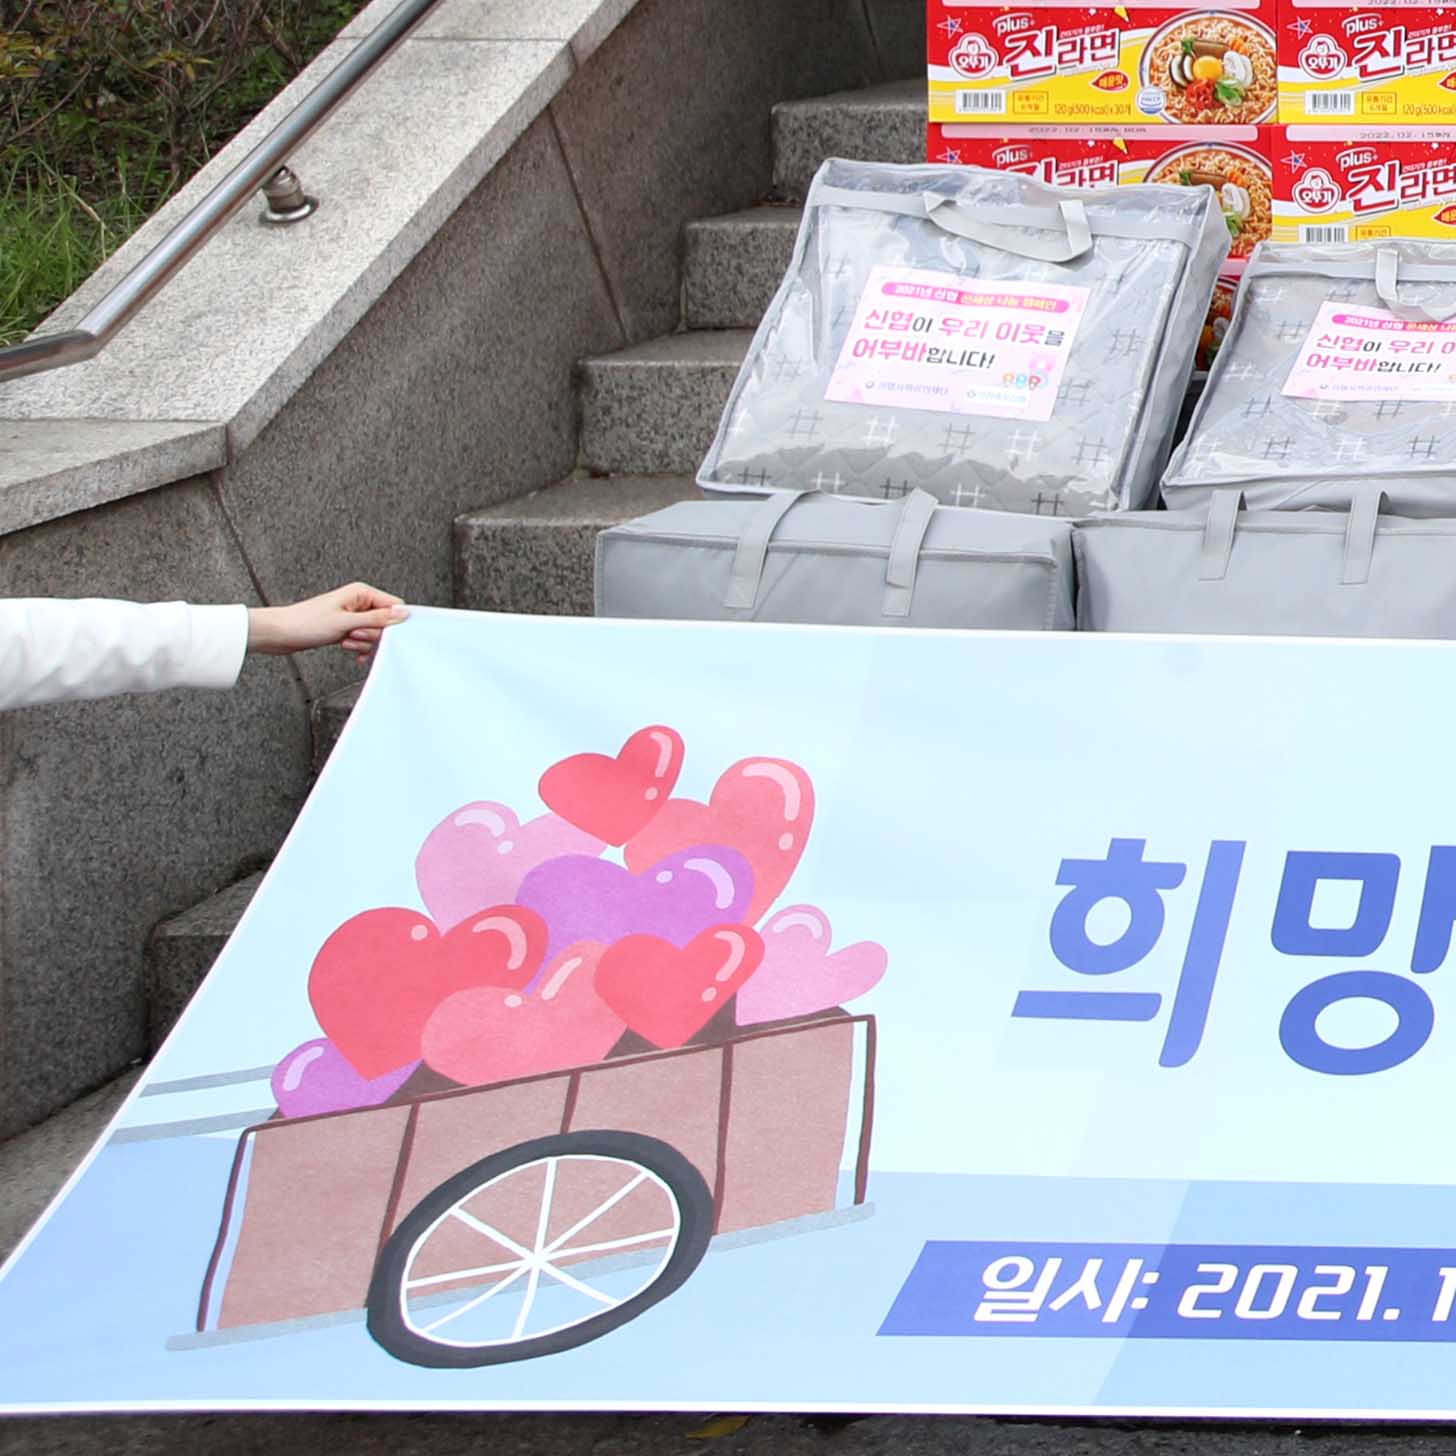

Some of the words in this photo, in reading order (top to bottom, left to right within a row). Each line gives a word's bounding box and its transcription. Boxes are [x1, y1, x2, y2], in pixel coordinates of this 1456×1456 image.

[1003, 27, 1121, 81] 진라면
[864, 309, 933, 333] 신협이
[938, 317, 988, 339] 우리
[996, 321, 1066, 347] 이웃을
[1316, 333, 1382, 353] 신협이
[1387, 339, 1434, 354] 우리
[852, 338, 995, 369] 어부바합니다!
[1306, 353, 1442, 373] 어부바합니다!
[974, 1256, 1158, 1324] 일시:
[1177, 1263, 1400, 1321] 2021.
